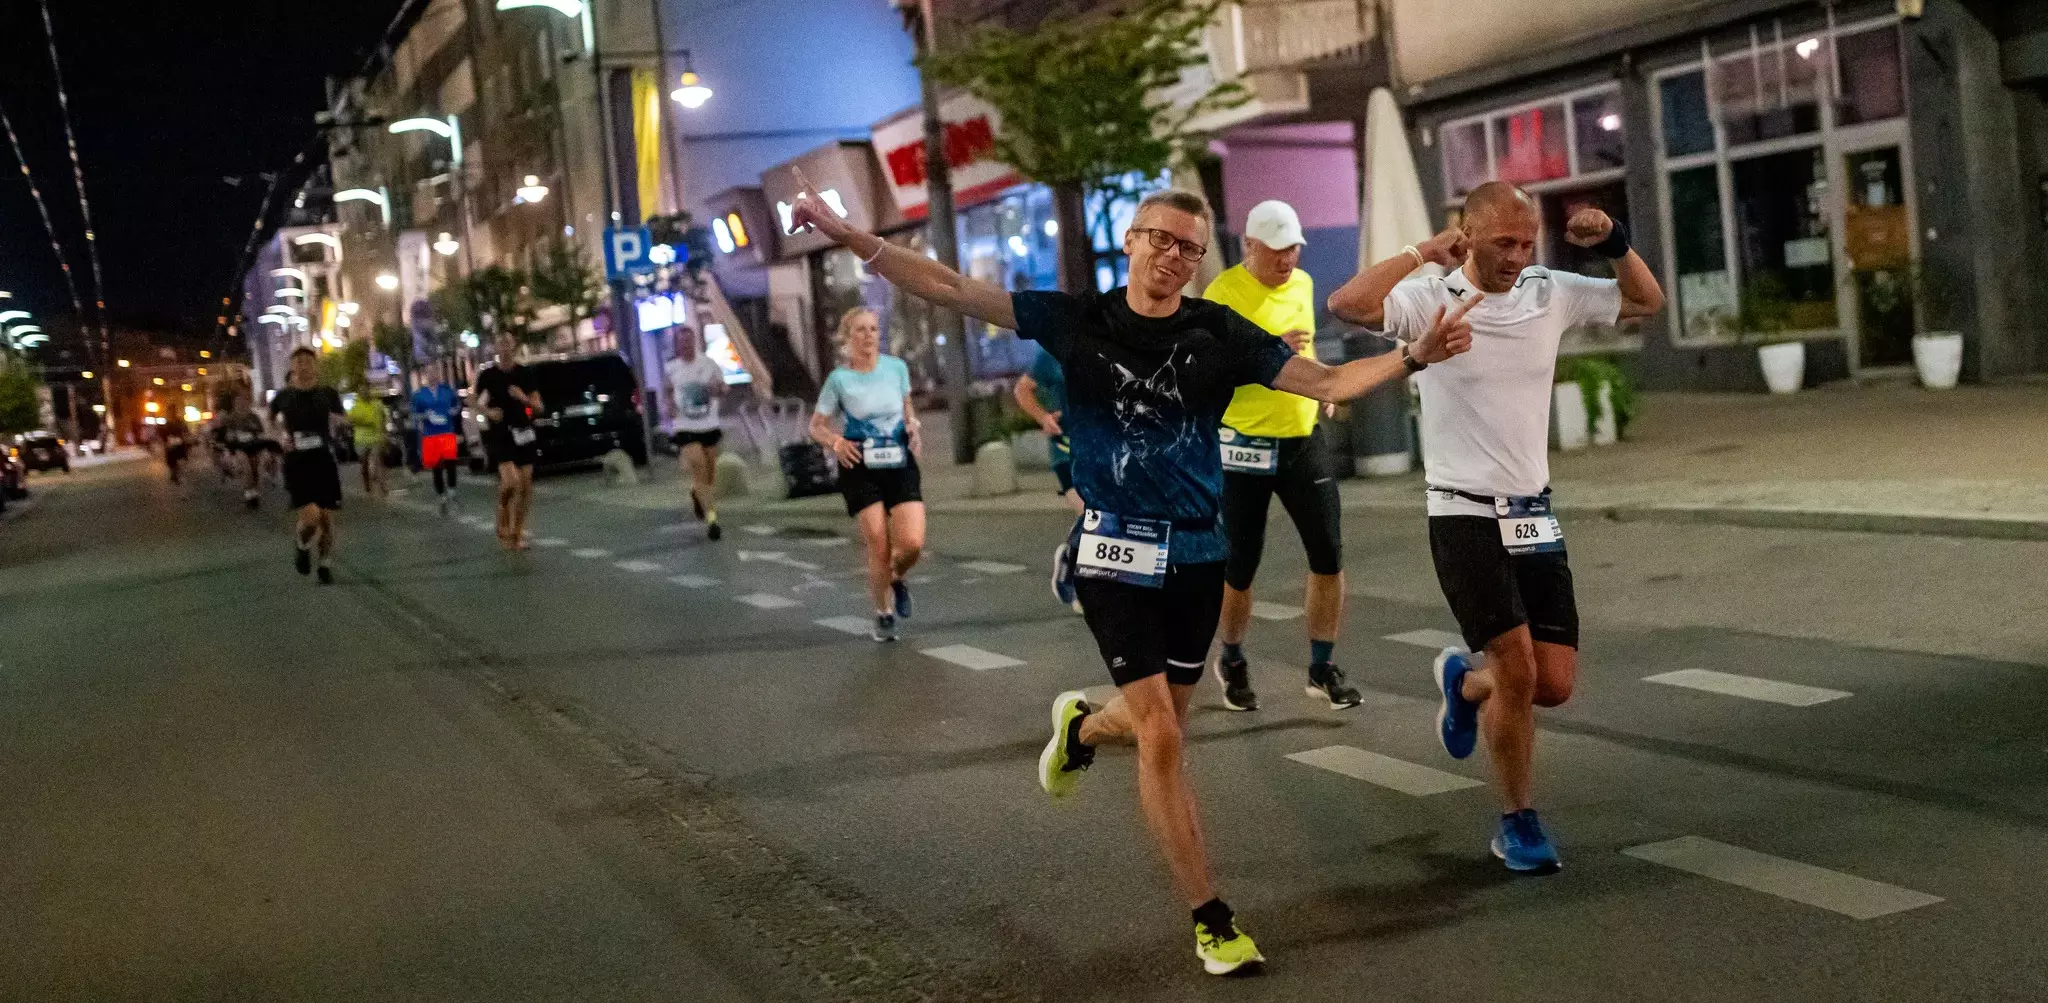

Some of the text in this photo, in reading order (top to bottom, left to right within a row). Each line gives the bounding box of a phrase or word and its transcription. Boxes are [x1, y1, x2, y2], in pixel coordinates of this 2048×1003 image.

[613, 232, 641, 272] P
[1228, 450, 1261, 463] 1025
[1515, 523, 1539, 539] 628
[1095, 542, 1135, 564] 885
